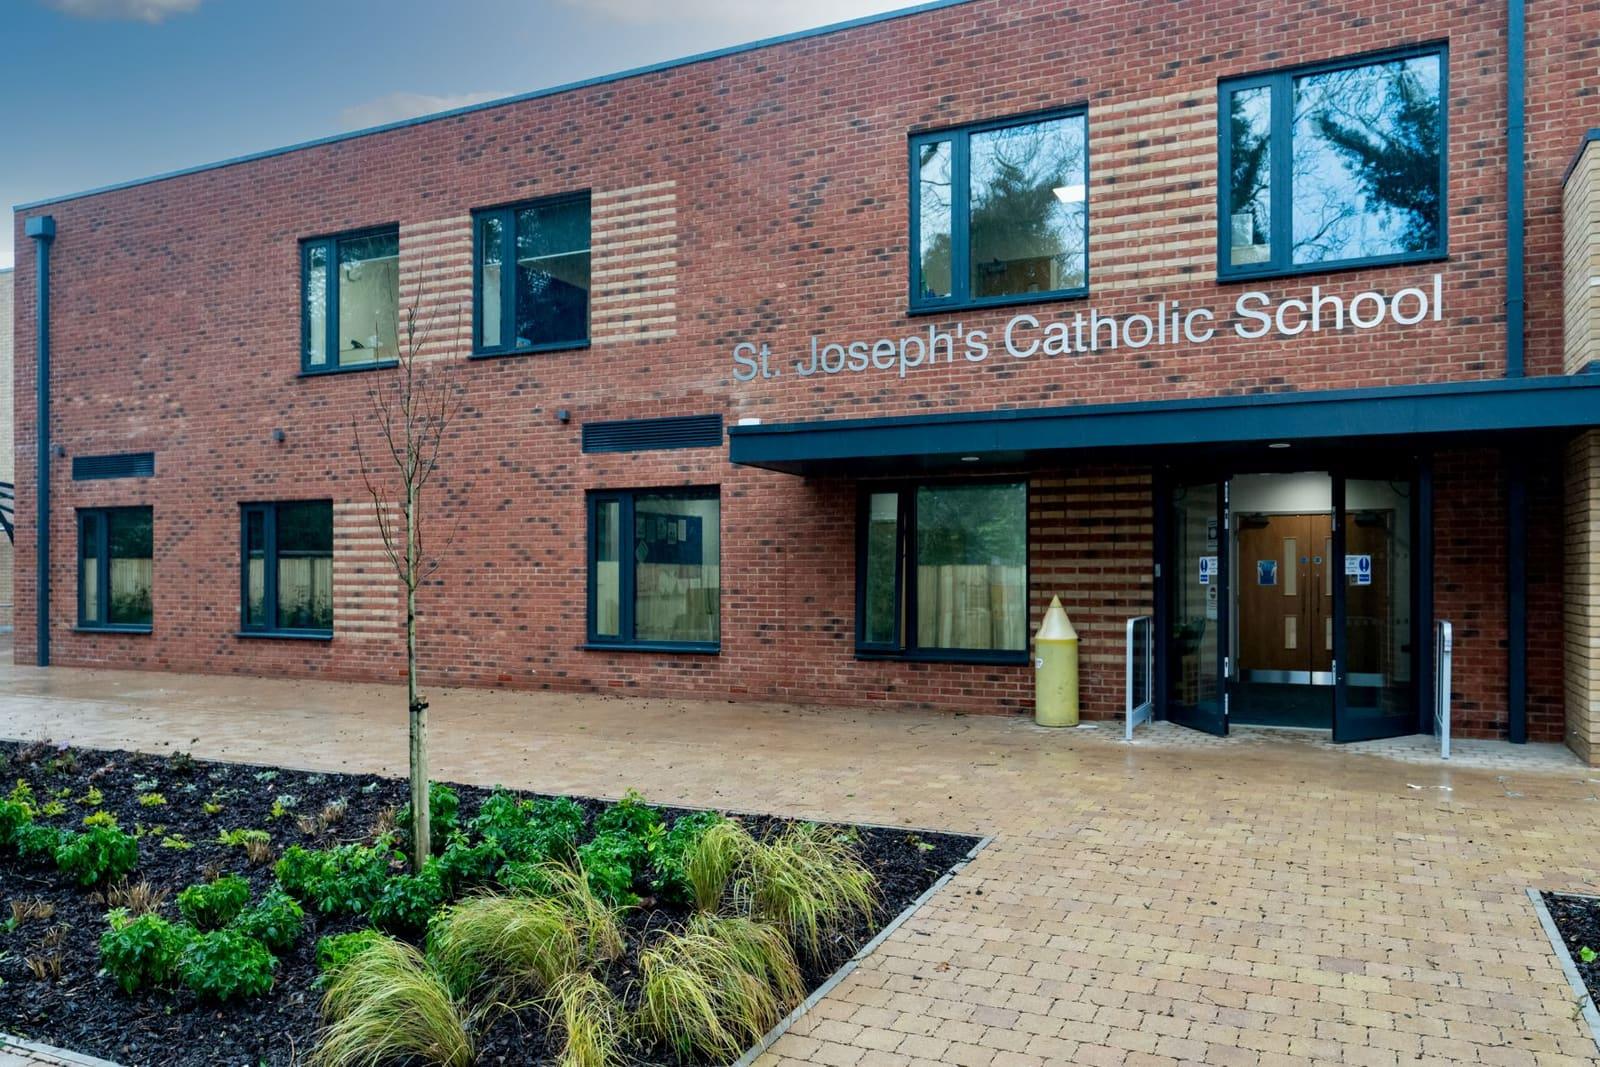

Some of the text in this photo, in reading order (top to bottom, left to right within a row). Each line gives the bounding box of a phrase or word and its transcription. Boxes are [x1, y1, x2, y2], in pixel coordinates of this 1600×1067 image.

[733, 273, 1443, 382] St. Joseph's Catholic School
